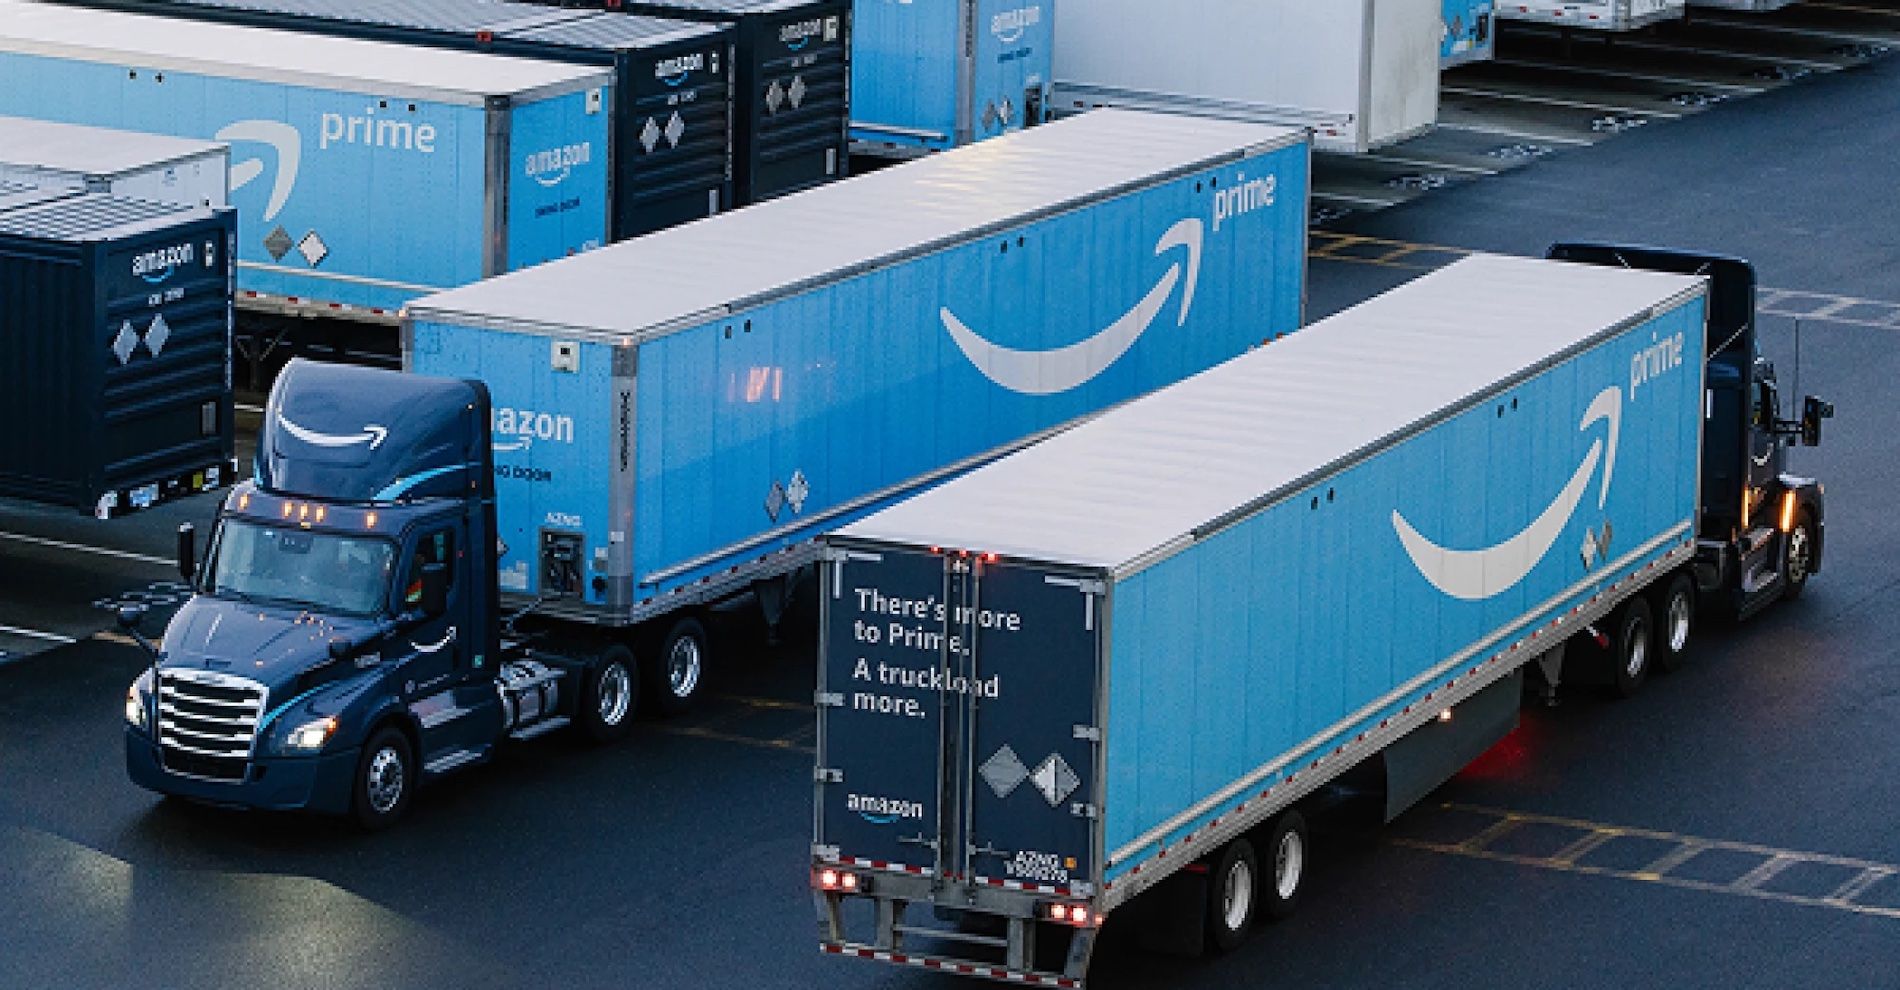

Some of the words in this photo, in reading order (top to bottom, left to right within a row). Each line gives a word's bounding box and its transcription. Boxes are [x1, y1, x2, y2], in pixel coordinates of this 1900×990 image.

[320, 107, 436, 153] prime
[525, 142, 590, 176] amazon
[1212, 172, 1276, 232] prime
[1630, 331, 1685, 402] prime
[490, 407, 574, 443] azon
[855, 588, 945, 622] There's
[954, 606, 1020, 631] more
[854, 620, 882, 643] to
[889, 622, 969, 656] Prime.
[852, 657, 872, 681] A
[878, 660, 999, 699] truckload
[854, 693, 926, 719] more.
[846, 793, 923, 819] amazon
